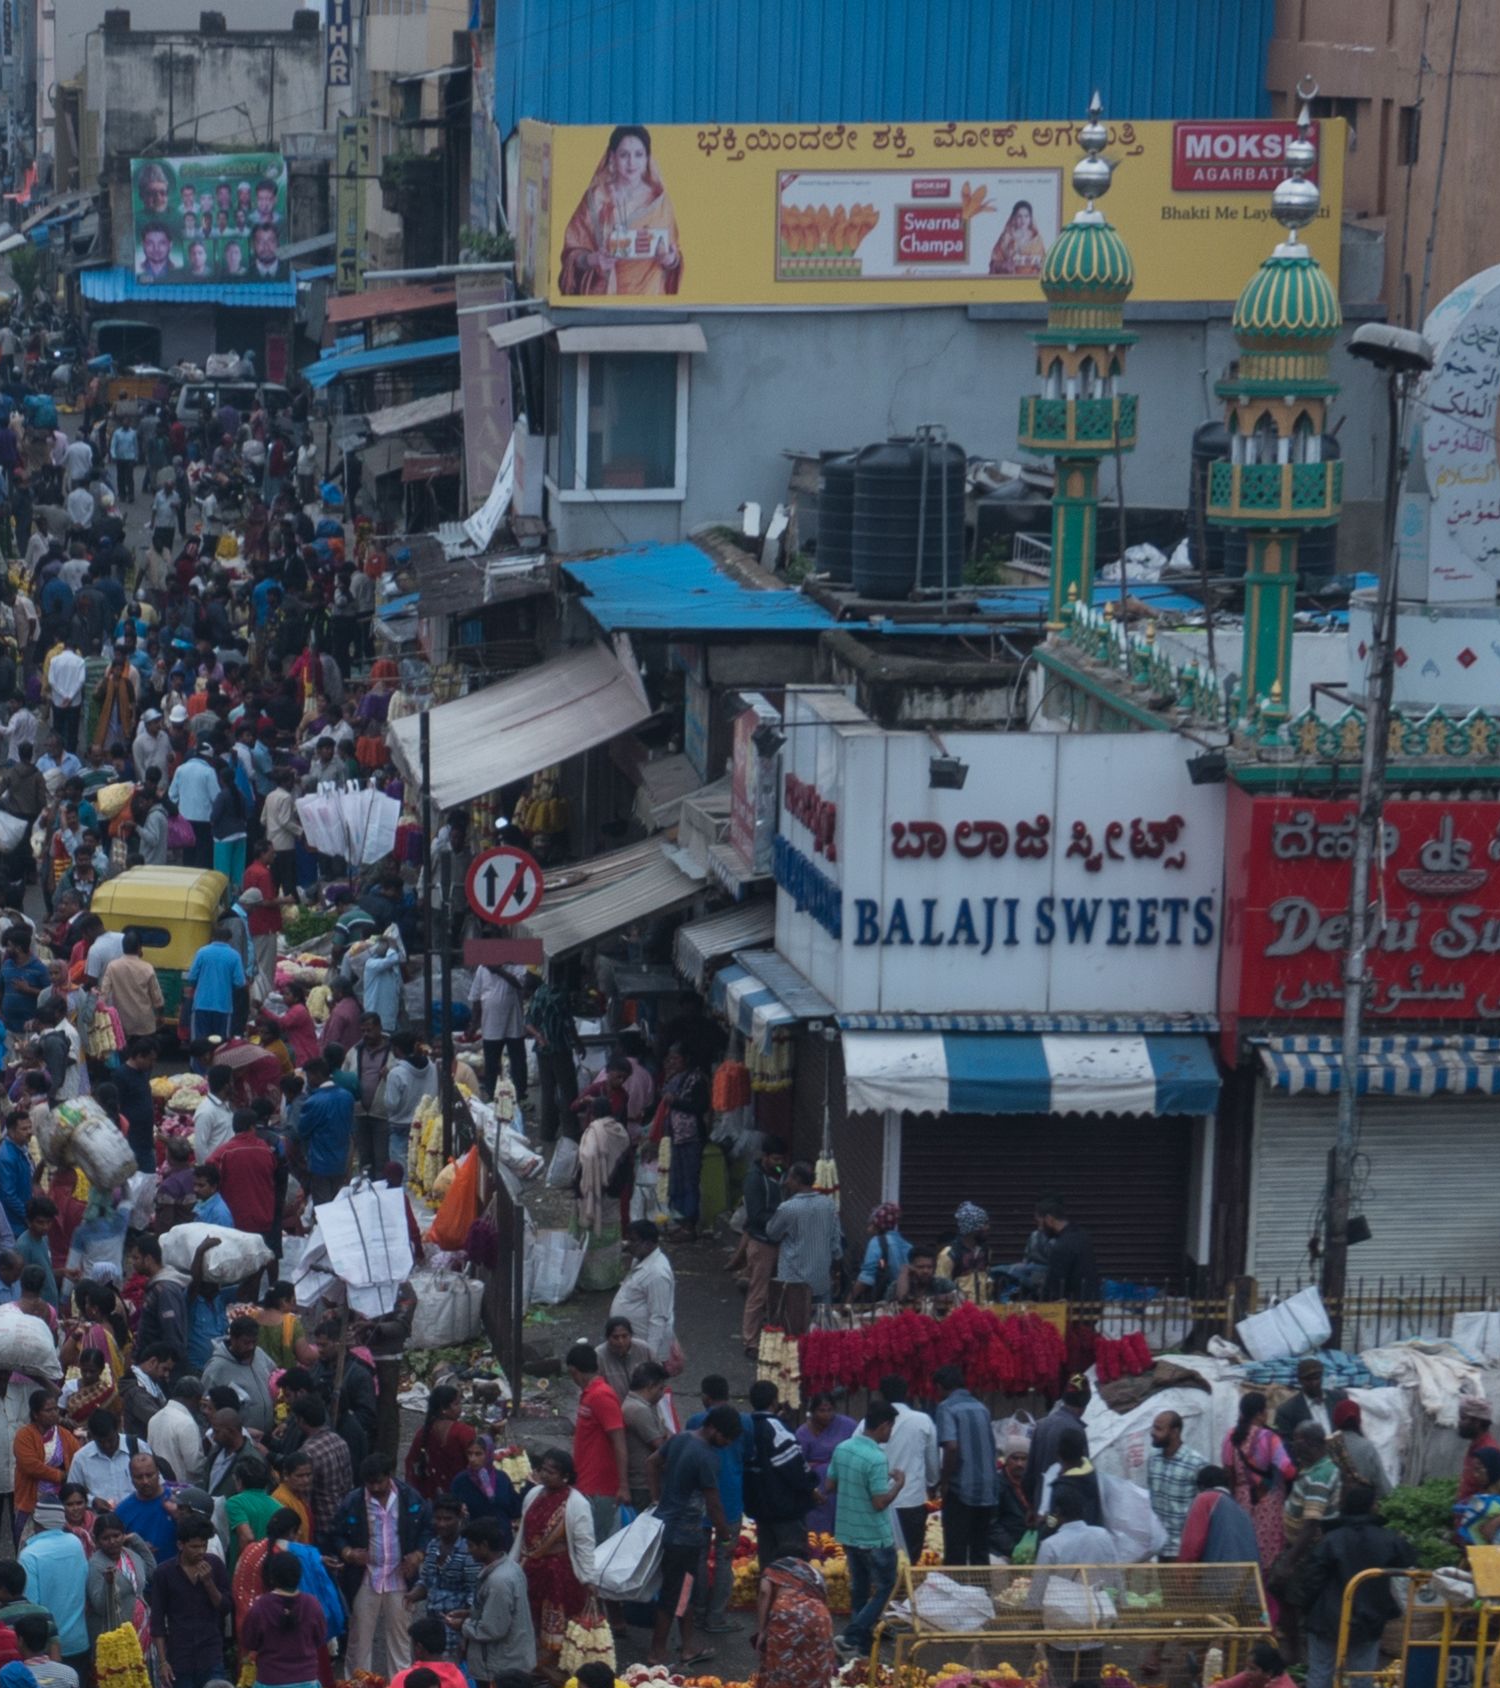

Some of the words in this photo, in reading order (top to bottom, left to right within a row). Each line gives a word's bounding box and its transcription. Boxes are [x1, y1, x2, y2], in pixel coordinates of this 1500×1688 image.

[329, 0, 349, 83] IHAR
[697, 124, 859, 161] ಭಕ್ತಿಯಿಂದಲೇ
[872, 126, 916, 158] ಶಕ್ತಿ
[1185, 133, 1300, 160] MOKS
[904, 213, 961, 231] Swarna
[1161, 206, 1214, 220] Bhakti
[1223, 206, 1239, 220] Me
[900, 236, 963, 256] Champa
[891, 814, 1051, 860] ಬಾಲಾಜಿ
[853, 898, 1020, 956] BALAJI
[1034, 896, 1216, 948] SWEETS
